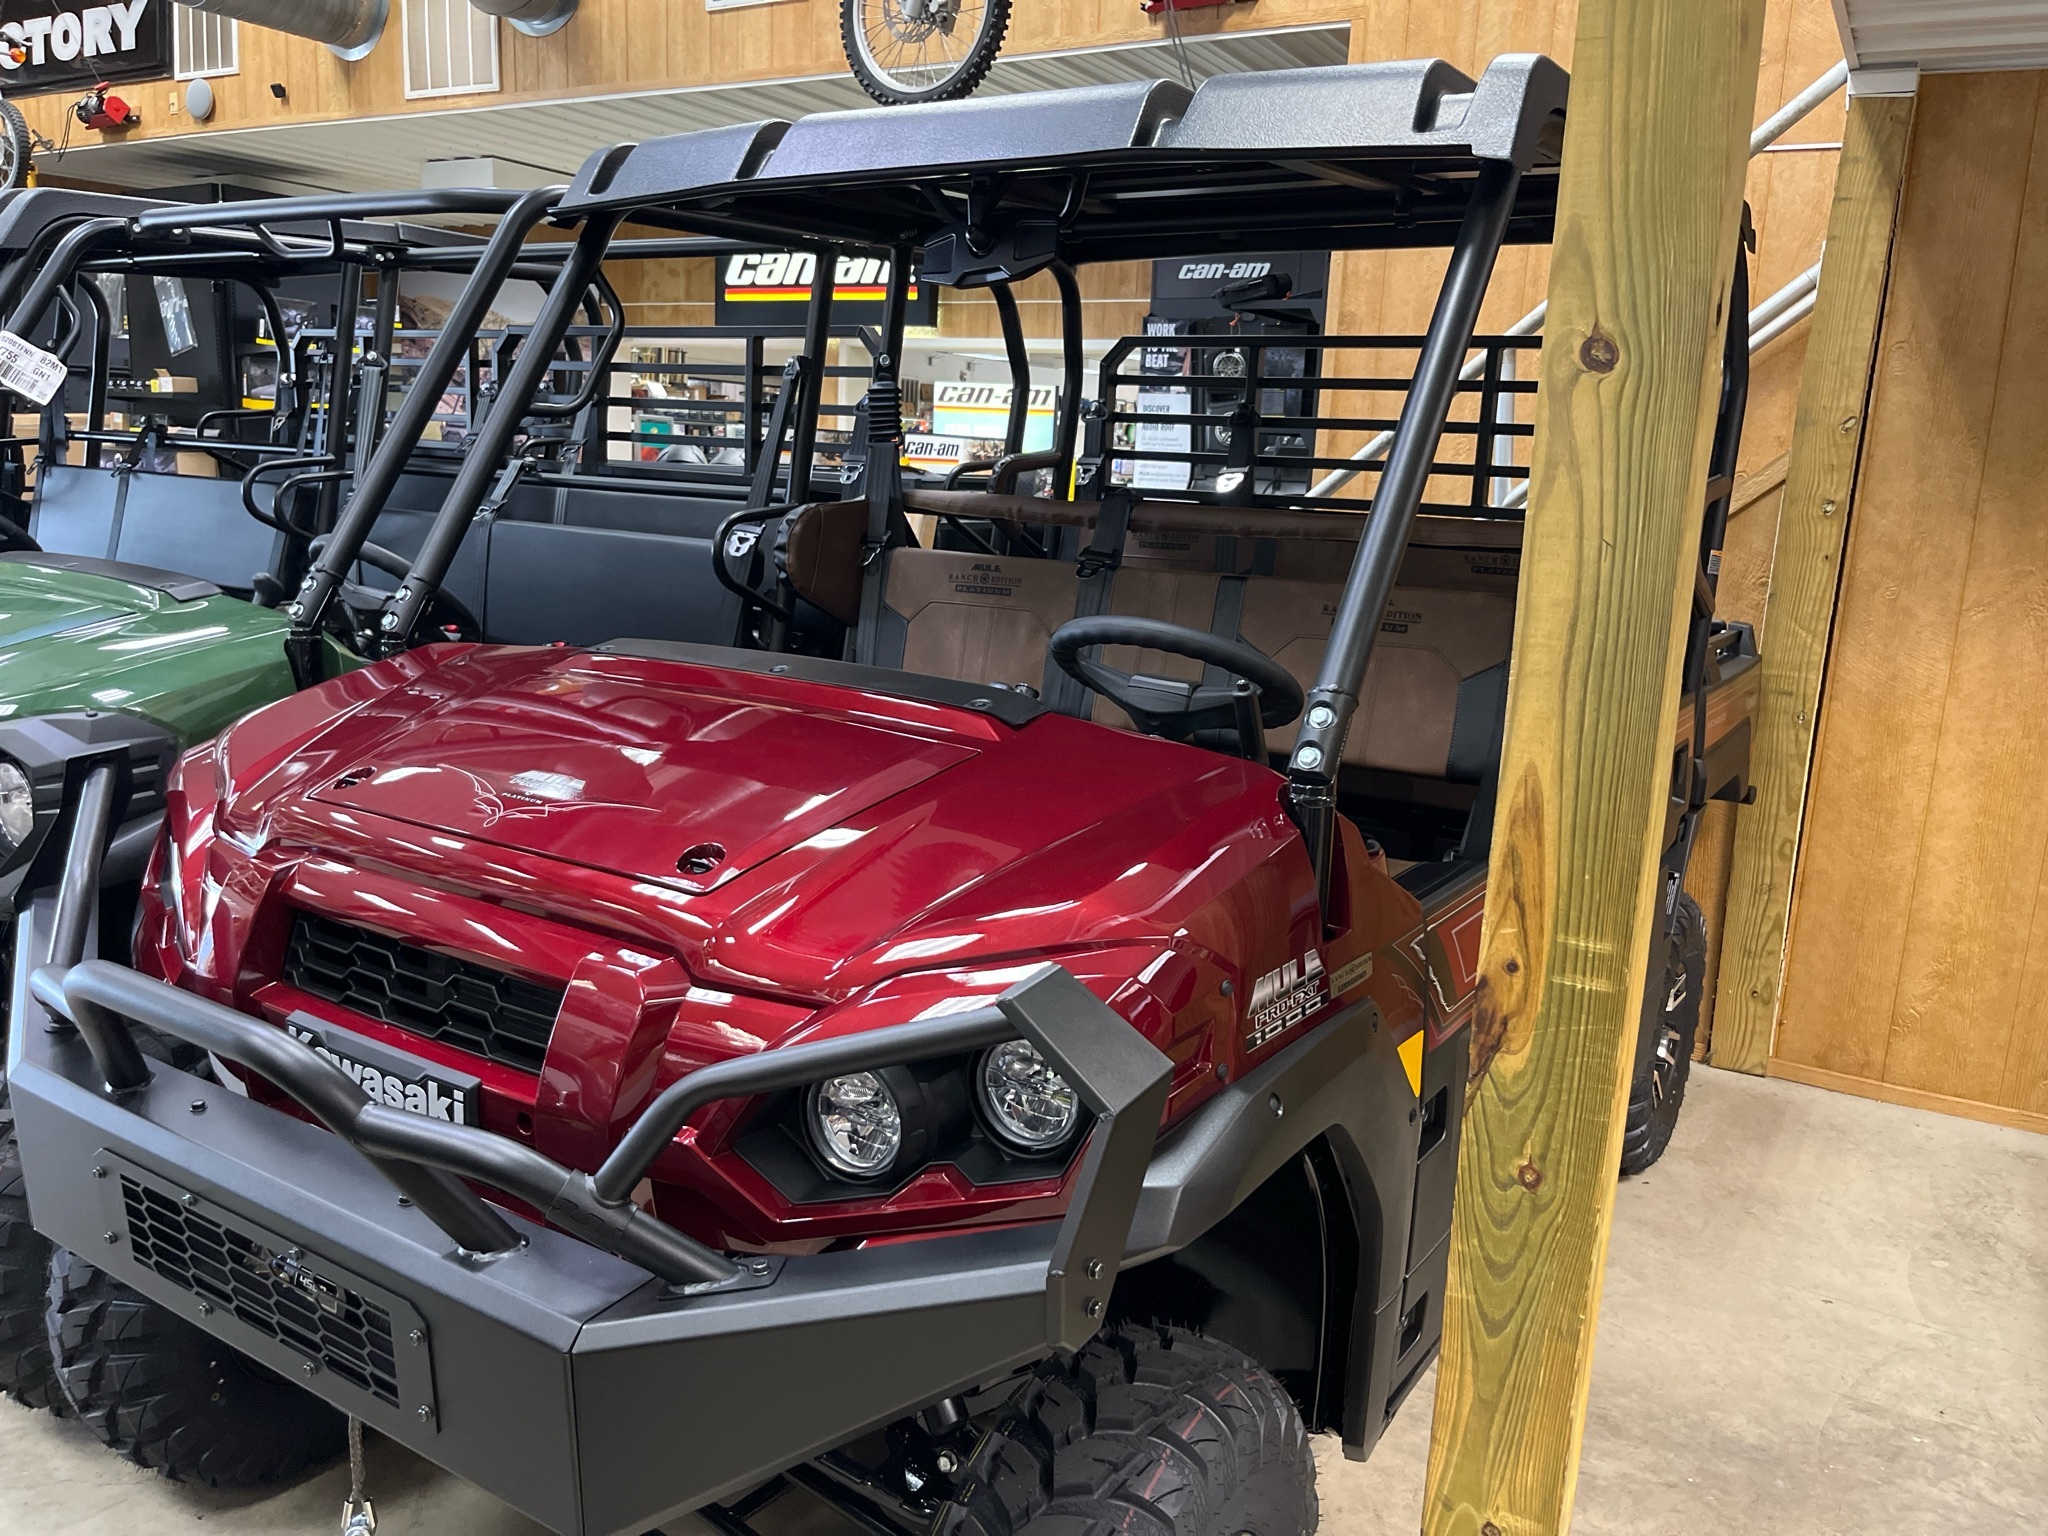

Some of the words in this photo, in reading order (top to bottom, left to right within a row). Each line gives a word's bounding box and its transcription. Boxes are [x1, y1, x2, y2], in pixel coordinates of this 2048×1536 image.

[1178, 263, 1271, 279] can-am
[1147, 323, 1176, 337] WORK
[1145, 354, 1169, 368] BEAT
[32, 367, 51, 381] GN1
[1142, 404, 1171, 413] DISCOVER
[905, 441, 960, 457] can-am
[970, 563, 1002, 573] MULE
[948, 573, 979, 582] RANCH
[990, 575, 1023, 585] EDITION
[956, 585, 1011, 595] PLATINUM
[1385, 610, 1423, 621] DITION
[501, 792, 544, 804] PLATINUM
[1247, 948, 1327, 1019] MULE
[1254, 995, 1322, 1045] 1000
